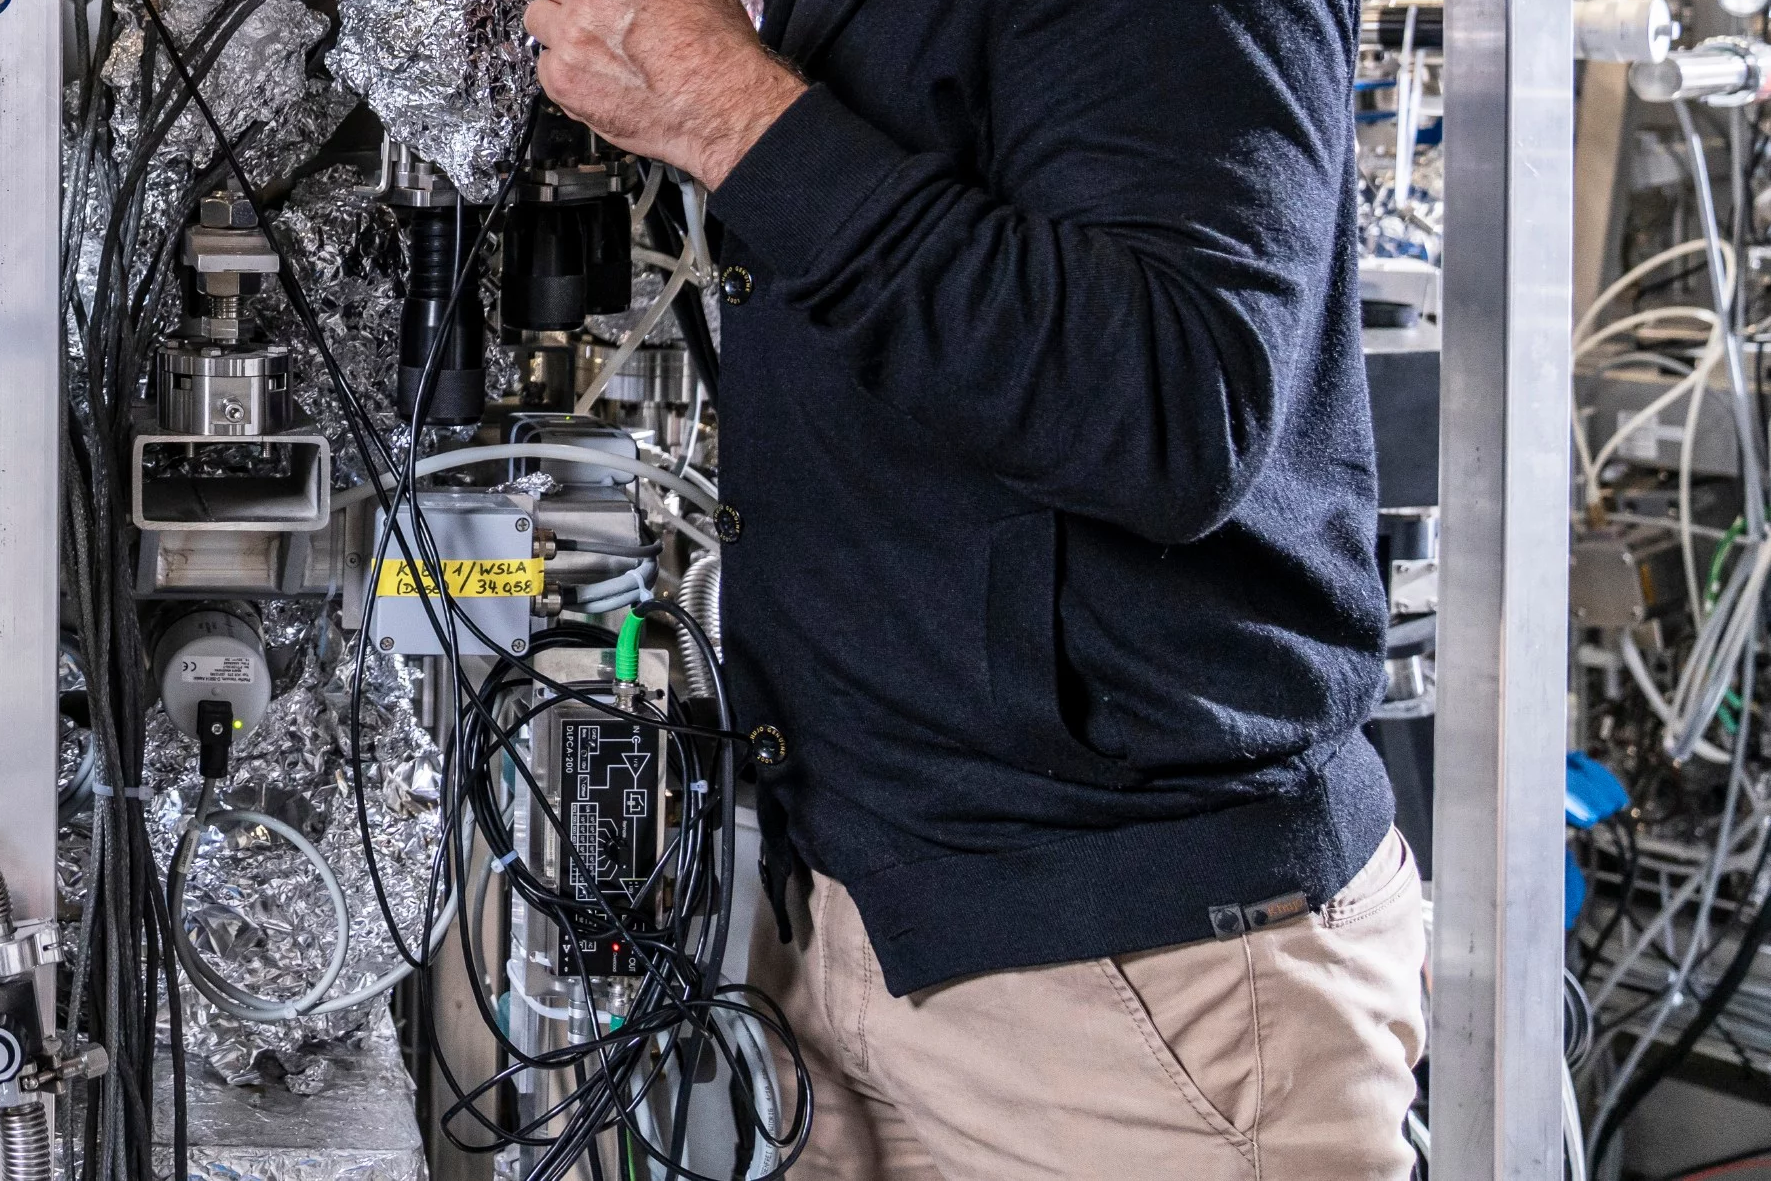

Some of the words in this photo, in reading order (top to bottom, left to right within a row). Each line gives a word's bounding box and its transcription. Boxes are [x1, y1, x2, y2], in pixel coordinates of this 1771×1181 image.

[633, 725, 640, 733] IN
[566, 726, 574, 774] DLPCA-200
[628, 957, 636, 972] OUT
